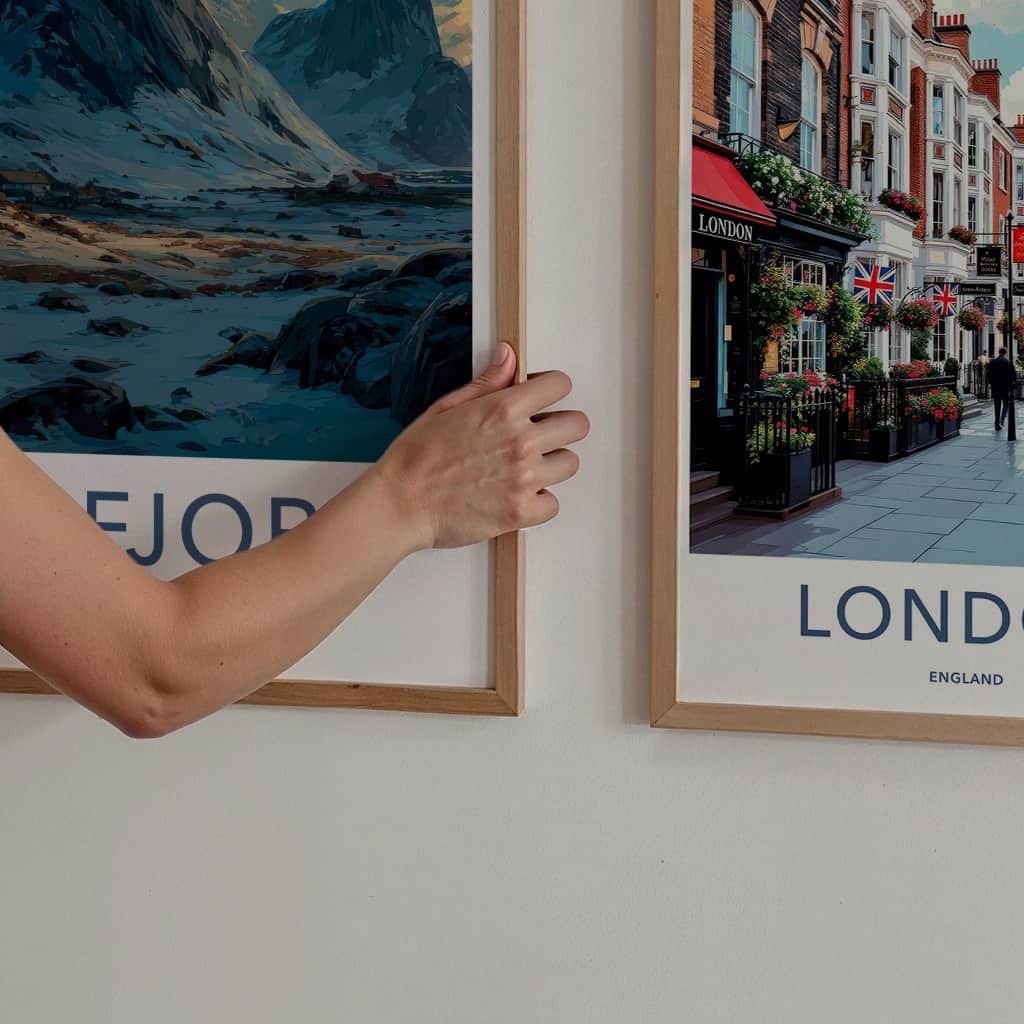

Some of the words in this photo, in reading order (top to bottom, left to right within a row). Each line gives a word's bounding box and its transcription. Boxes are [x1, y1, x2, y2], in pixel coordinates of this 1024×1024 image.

[698, 213, 753, 242] LONDON
[800, 584, 1024, 645] LOND
[929, 670, 1004, 686] ENGLAND
